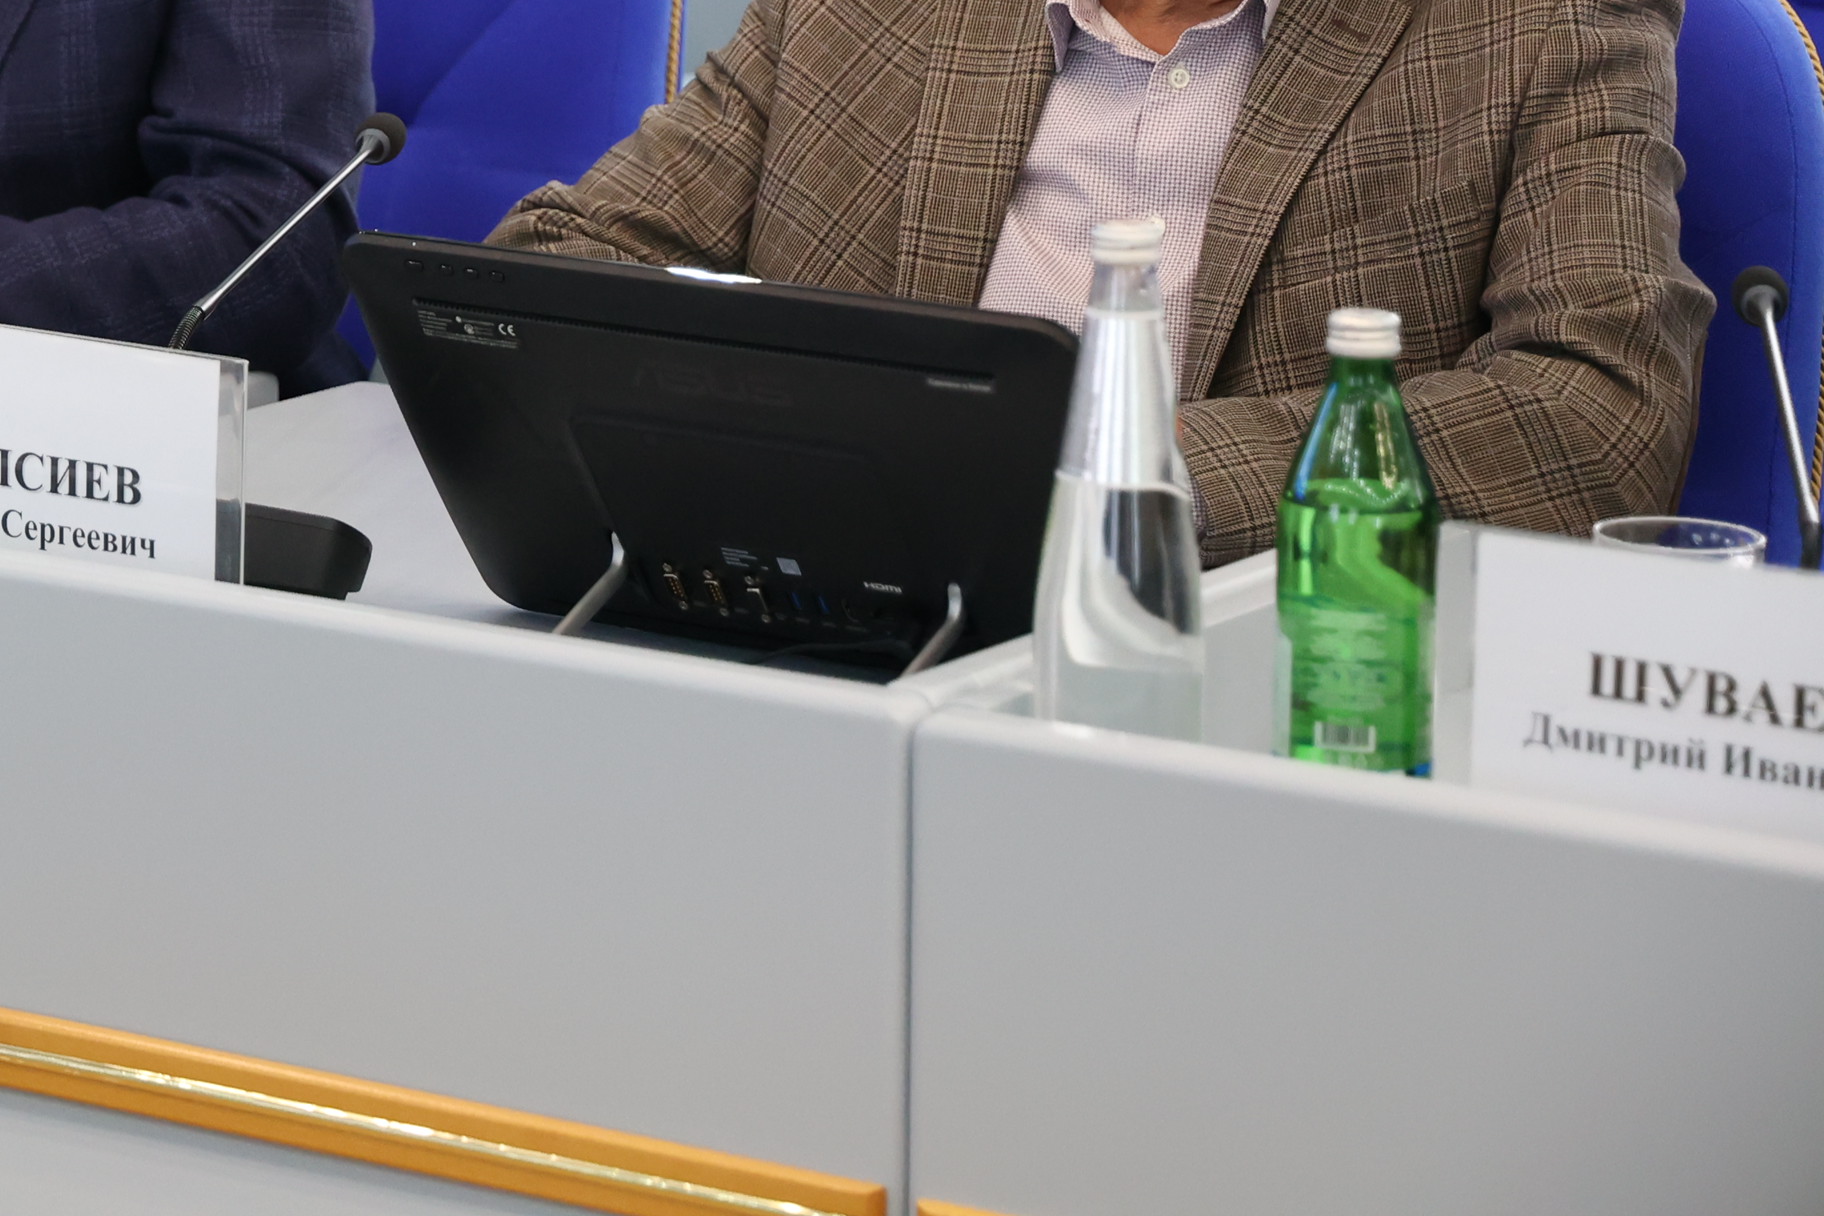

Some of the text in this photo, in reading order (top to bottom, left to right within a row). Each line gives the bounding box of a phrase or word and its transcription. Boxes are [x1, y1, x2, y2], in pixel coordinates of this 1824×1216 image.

[498, 323, 516, 336] CE
[1, 508, 156, 559] Сергеевич
[1523, 711, 1707, 770] Дмитрий
